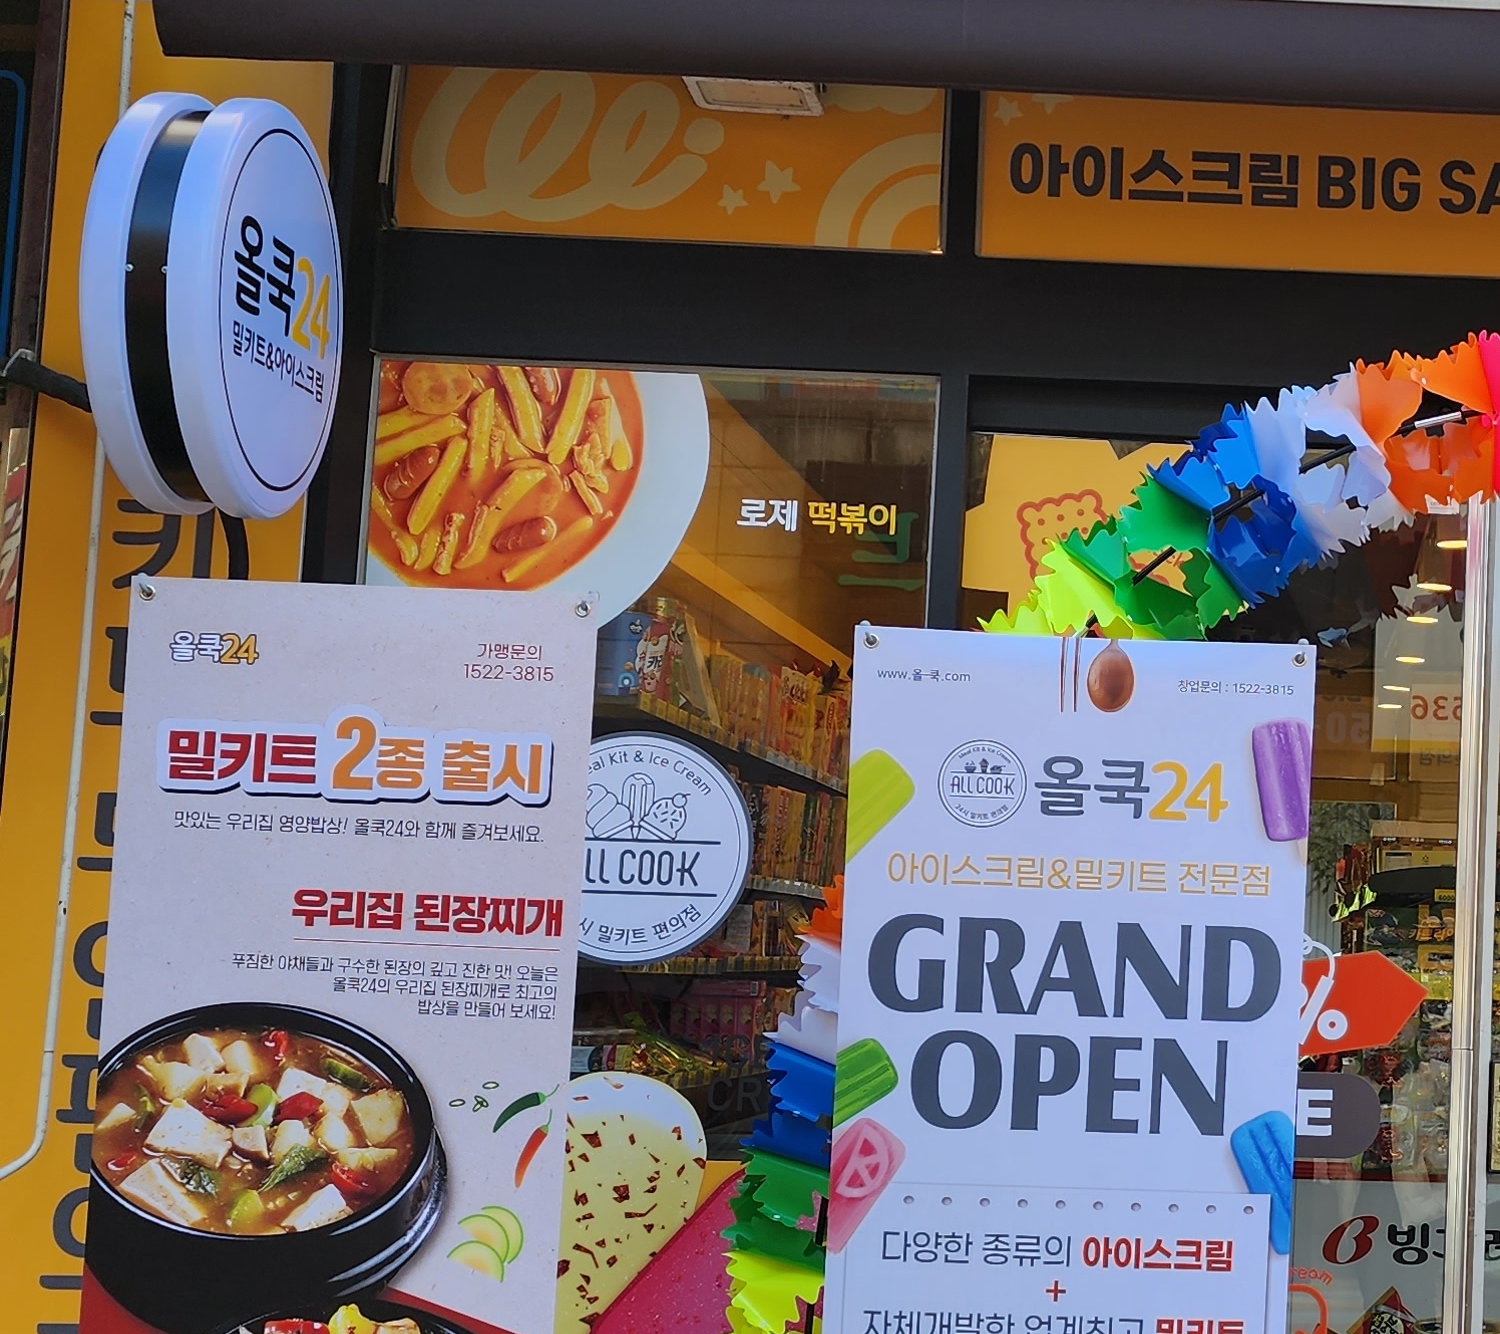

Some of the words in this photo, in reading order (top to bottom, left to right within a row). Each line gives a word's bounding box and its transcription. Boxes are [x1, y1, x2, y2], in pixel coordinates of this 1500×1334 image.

[1009, 141, 1299, 210] 아이스크림
[1316, 154, 1421, 213] BIG
[235, 215, 331, 359] 올쿡24
[231, 319, 325, 405] 밀키트&아이스크림
[736, 498, 798, 532] 로제
[806, 500, 898, 536] 떡볶이
[169, 630, 259, 665] 올쿡24
[477, 642, 542, 662] 가맹문의
[464, 663, 555, 683] 1522-3815
[1178, 679, 1222, 693] 창업문의
[1232, 683, 1294, 695] 1522-3815
[168, 729, 317, 783] 밀키트
[332, 716, 425, 791] 2종
[442, 740, 543, 795] 출시
[608, 751, 628, 765] Kit
[634, 751, 644, 762] &
[649, 751, 669, 767] Ice
[673, 760, 712, 796] Cream
[950, 775, 973, 794] ALL
[976, 776, 1015, 796] COOK
[1034, 755, 1229, 823] 올쿡24
[174, 810, 221, 831] 맛있는
[226, 813, 274, 833] 우리집
[279, 814, 348, 837] 영양밥상!
[354, 817, 420, 839] 올쿡24와
[425, 820, 457, 842] 함께
[461, 822, 544, 844] 즐겨보세요.
[619, 849, 700, 886] COOK
[887, 851, 1168, 894] 아이스크림&밀키트
[1178, 862, 1271, 897] 전문점
[291, 890, 403, 931] 우리집
[414, 894, 563, 937] 된장찌개
[598, 926, 648, 945] 밀키트
[652, 903, 701, 941] 편의점
[232, 953, 274, 971] 푸짐한
[278, 954, 334, 974] 야채들과
[338, 956, 380, 976] 구수한
[384, 958, 425, 978] 된장의
[430, 959, 458, 978] 깊고
[461, 961, 491, 979] 진한
[494, 962, 512, 980] 맛!
[516, 963, 558, 982] 오늘은
[332, 975, 390, 994] 올쿡24의
[394, 978, 436, 996] 우리집
[441, 980, 511, 999] 된장찌개로
[515, 983, 557, 1002] 최고의
[867, 913, 1282, 1022] GRAND
[418, 999, 459, 1018] 밥상을
[463, 1000, 506, 1019] 만들어
[510, 1002, 556, 1021] 보세요!
[910, 1029, 1229, 1137] OPEN
[881, 1230, 973, 1264] 다양한
[982, 1235, 1072, 1268] 종류의
[1082, 1235, 1234, 1272] 아이스크림
